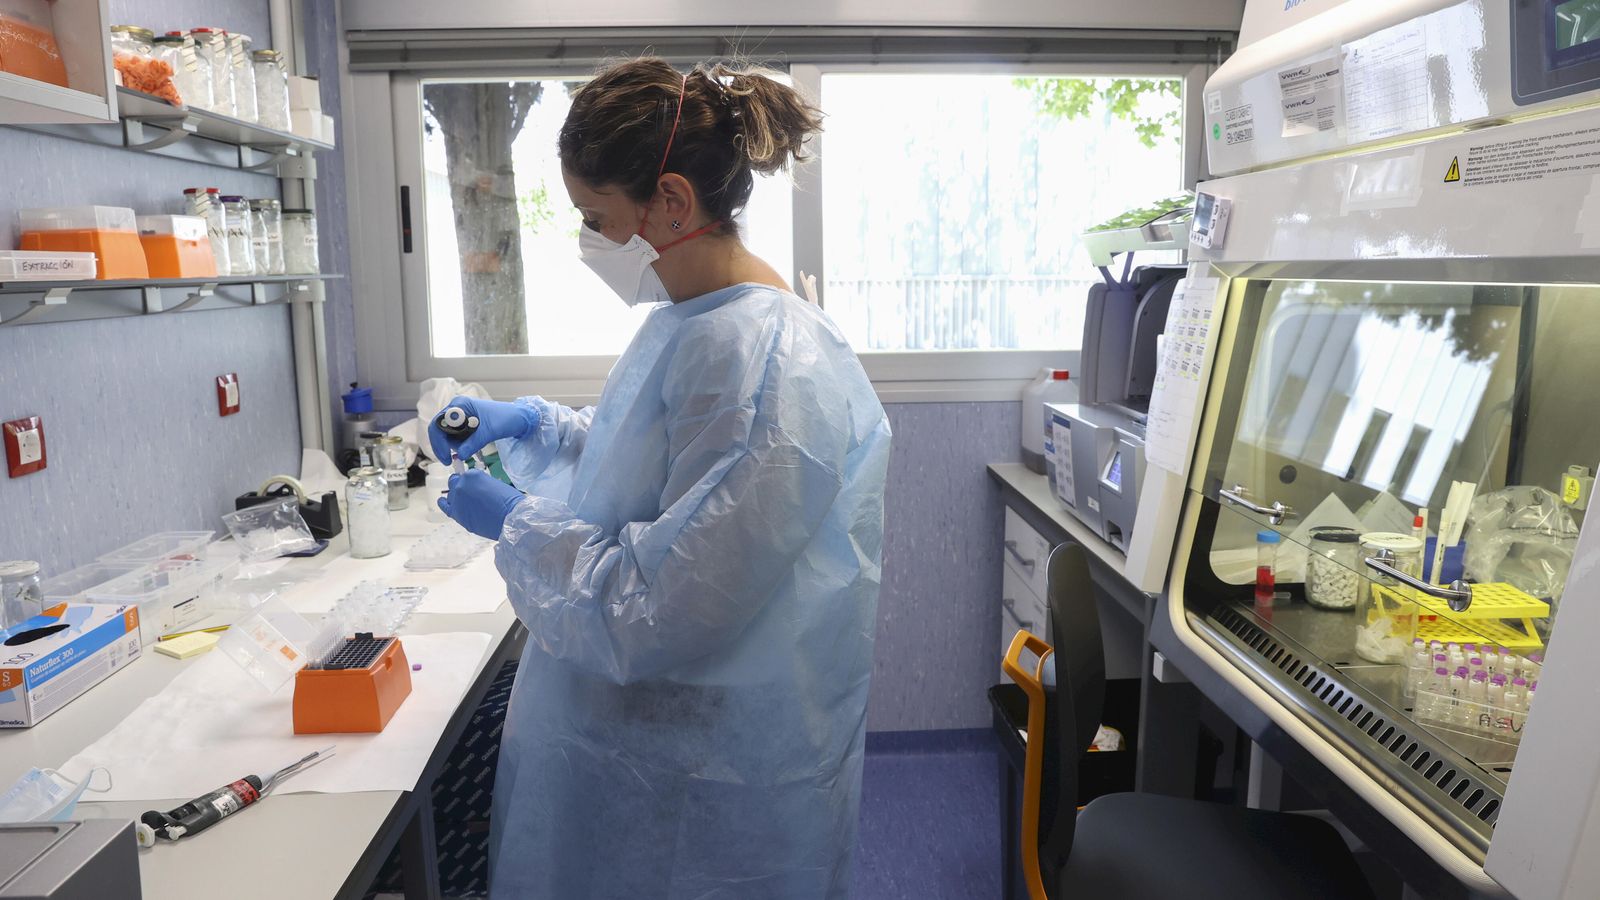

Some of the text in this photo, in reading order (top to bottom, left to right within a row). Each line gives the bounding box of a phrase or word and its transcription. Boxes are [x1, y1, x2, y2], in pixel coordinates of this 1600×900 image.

[22, 259, 73, 271] EXTRACCIÓN
[30, 647, 74, 678] Naturflex 300
[2, 672, 10, 682] S
